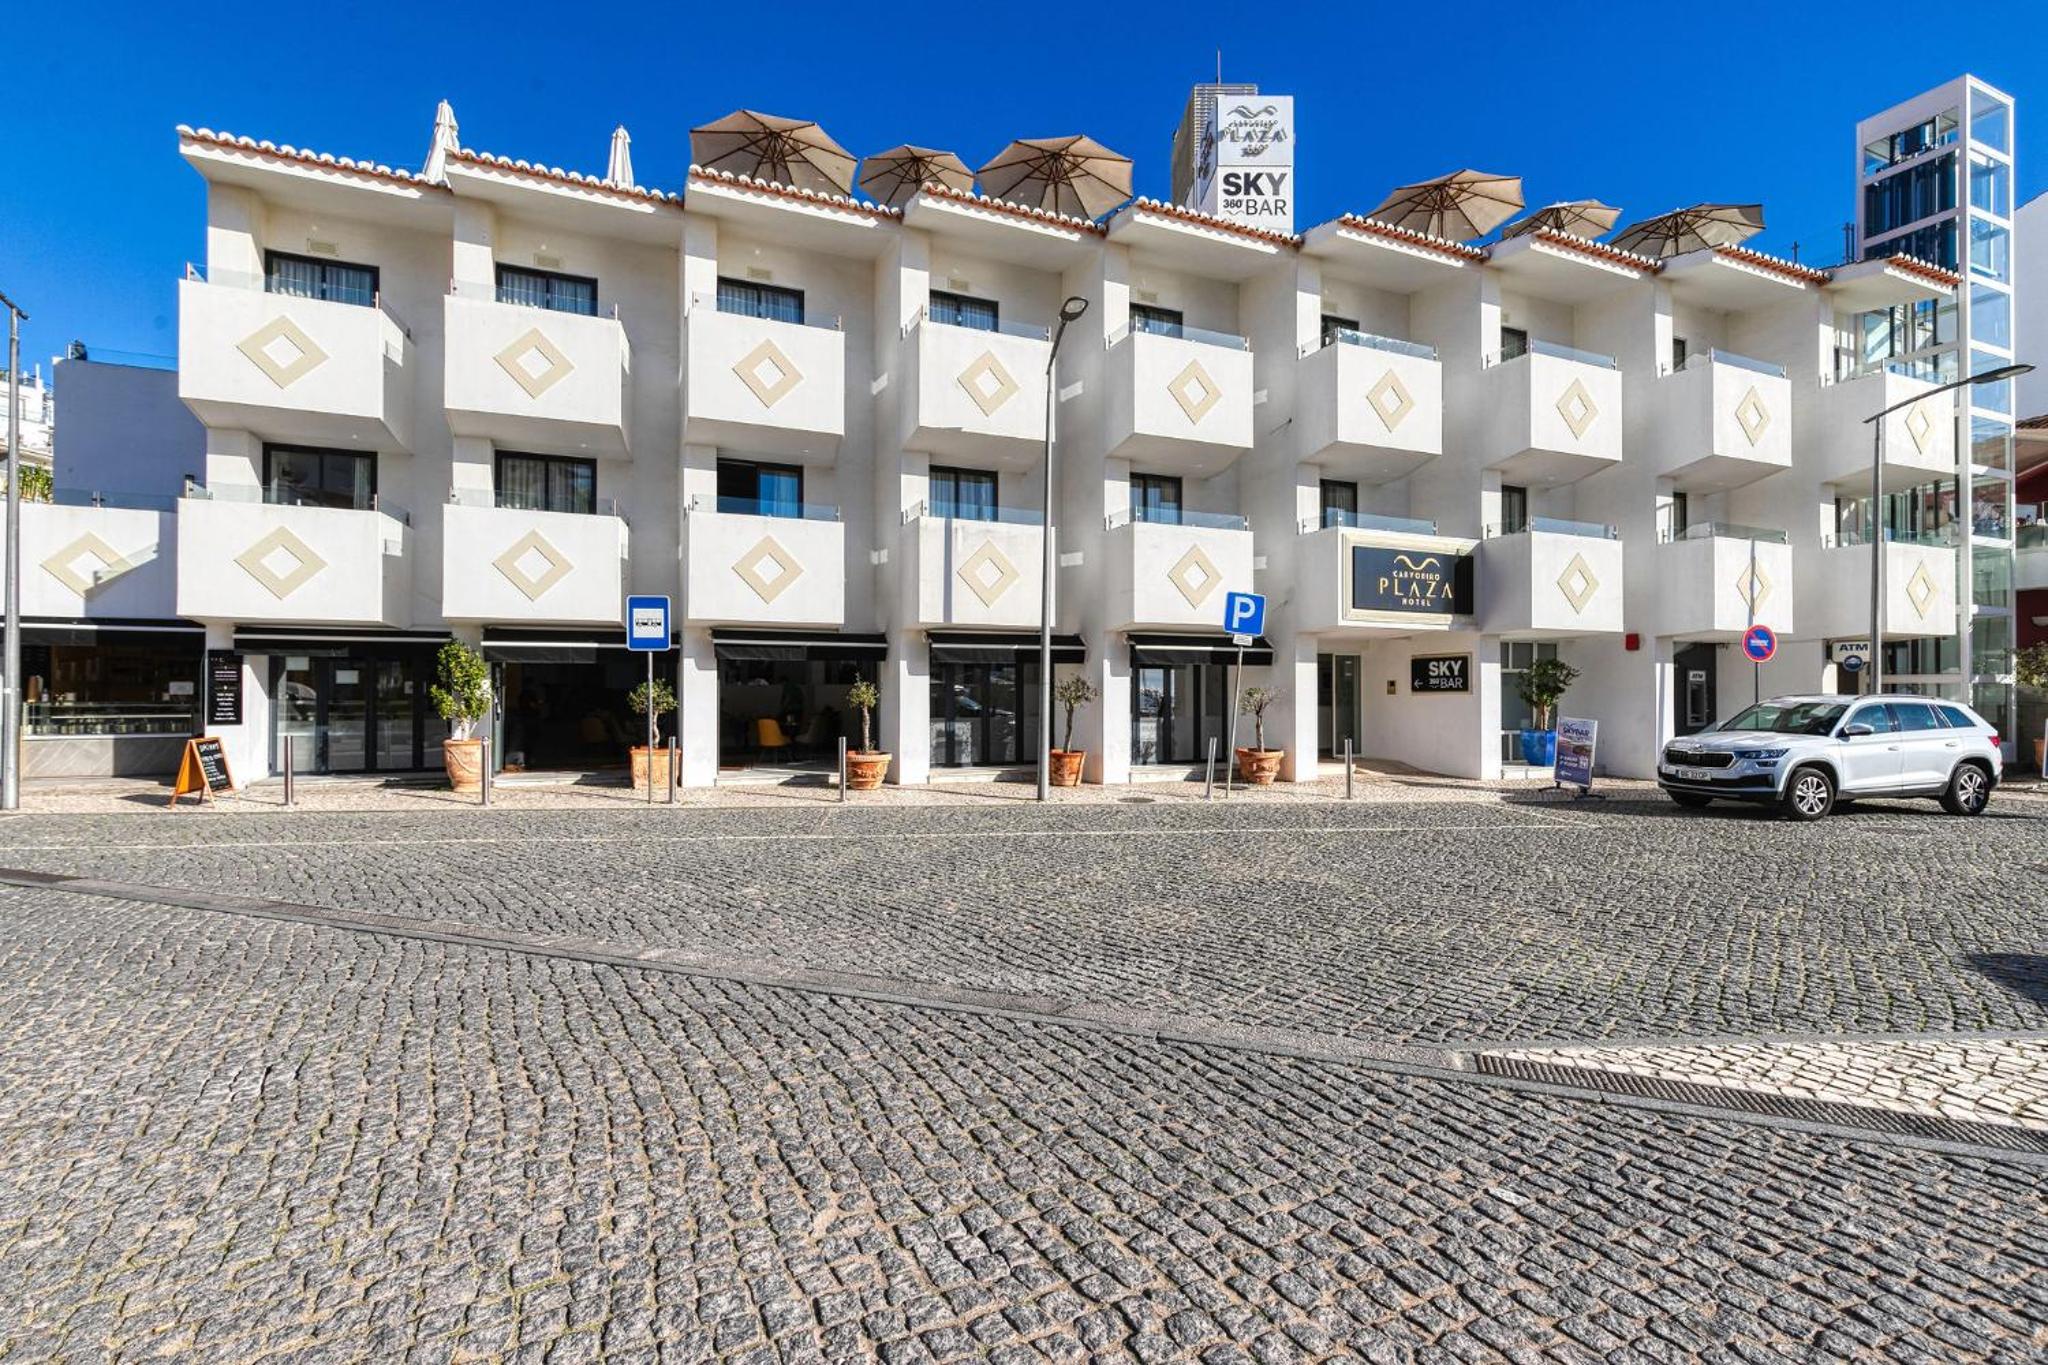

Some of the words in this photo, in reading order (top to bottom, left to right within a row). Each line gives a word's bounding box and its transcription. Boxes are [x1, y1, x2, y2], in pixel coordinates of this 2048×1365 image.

[1222, 126, 1288, 141] PLAZA
[1223, 172, 1288, 196] SKY
[1246, 199, 1287, 215] BAR
[1379, 577, 1453, 599] PLAZA
[1402, 598, 1432, 607] HOTEL
[1232, 596, 1256, 629] P
[1839, 643, 1868, 651] ATM
[1428, 660, 1462, 676] SKY
[1440, 677, 1463, 688] BAR
